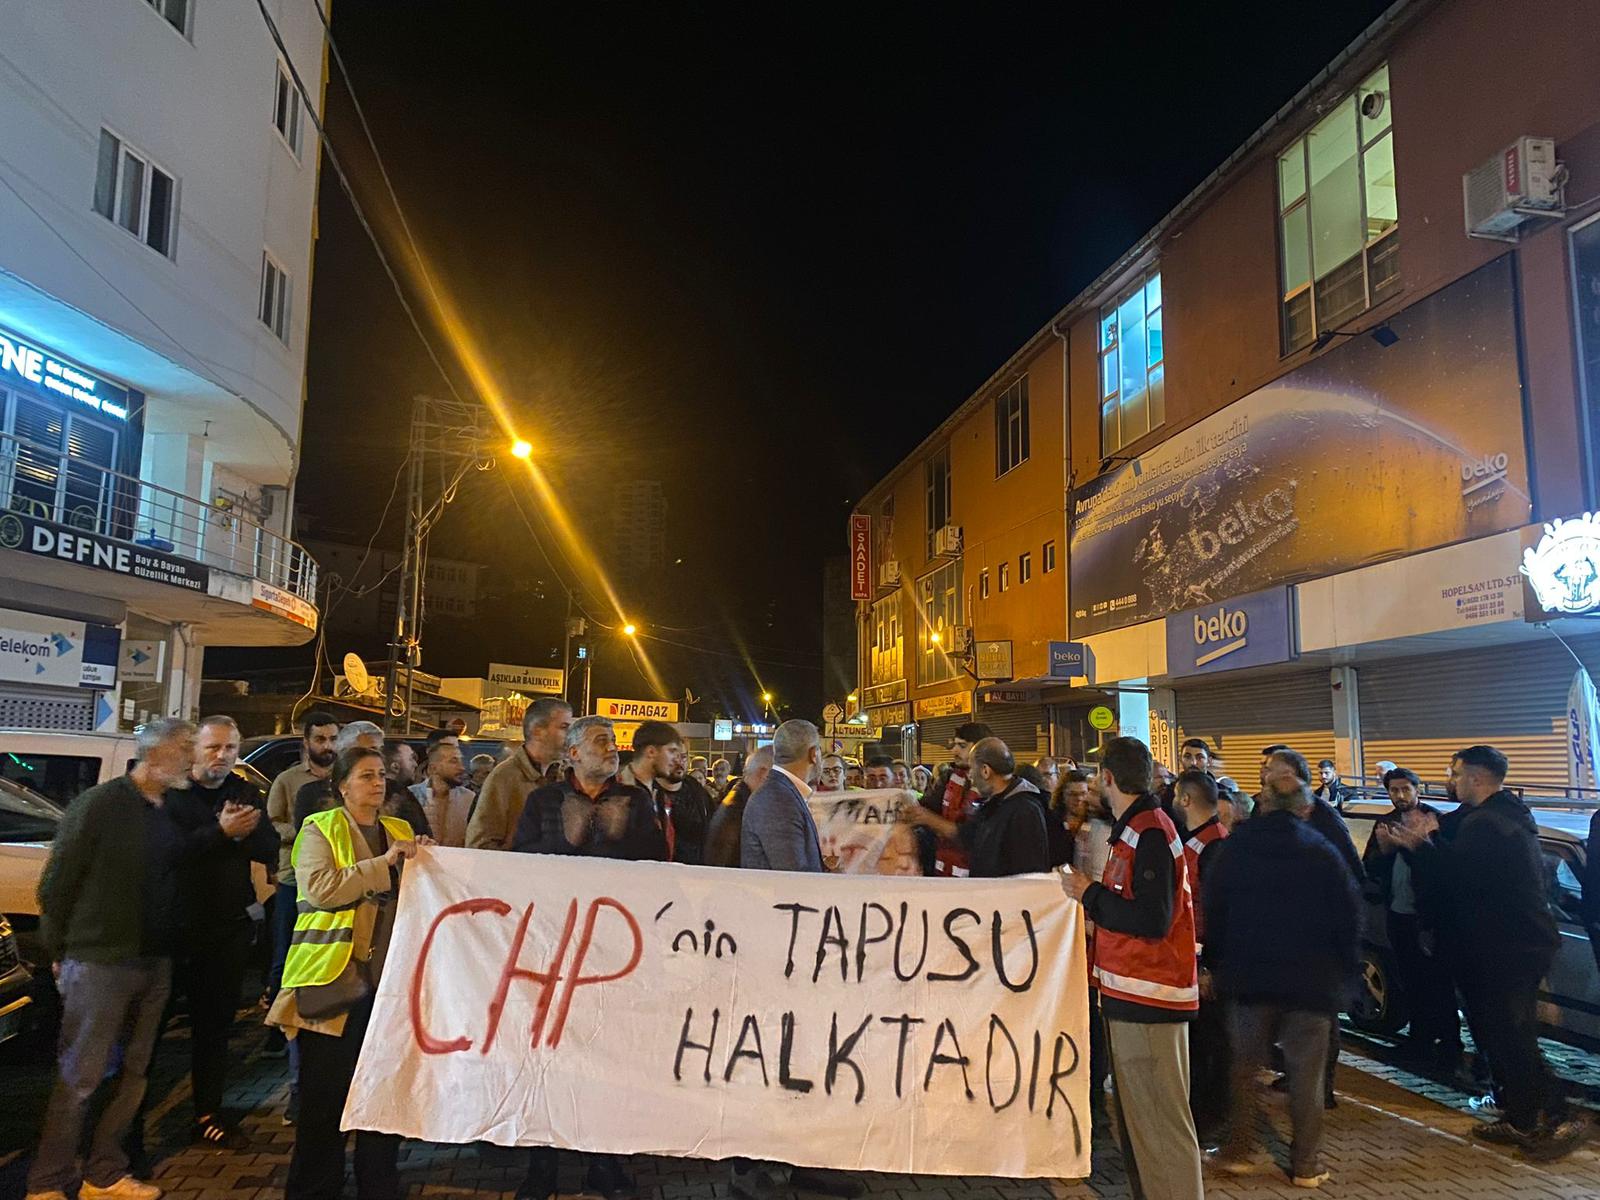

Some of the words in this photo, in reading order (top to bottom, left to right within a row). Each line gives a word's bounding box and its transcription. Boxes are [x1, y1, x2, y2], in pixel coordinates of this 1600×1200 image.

[1462, 452, 1508, 481] beko
[1189, 487, 1295, 561] beko
[32, 525, 131, 573] DEFNE
[856, 532, 866, 591] SAADET
[134, 553, 152, 569] Bay
[152, 558, 159, 568] &
[160, 560, 186, 575] Bayan
[170, 575, 201, 589] Merkezi
[1441, 583, 1486, 599] HOPELSAN
[1193, 608, 1247, 645] beko
[1053, 650, 1081, 662] beko
[491, 674, 521, 685] AŞIKLAR
[522, 676, 560, 689] BALIKÇILIK
[831, 727, 878, 737] ALTUNSOY
[774, 901, 1039, 993] TAPUSU
[674, 1006, 1081, 1156] HALKTADIR
